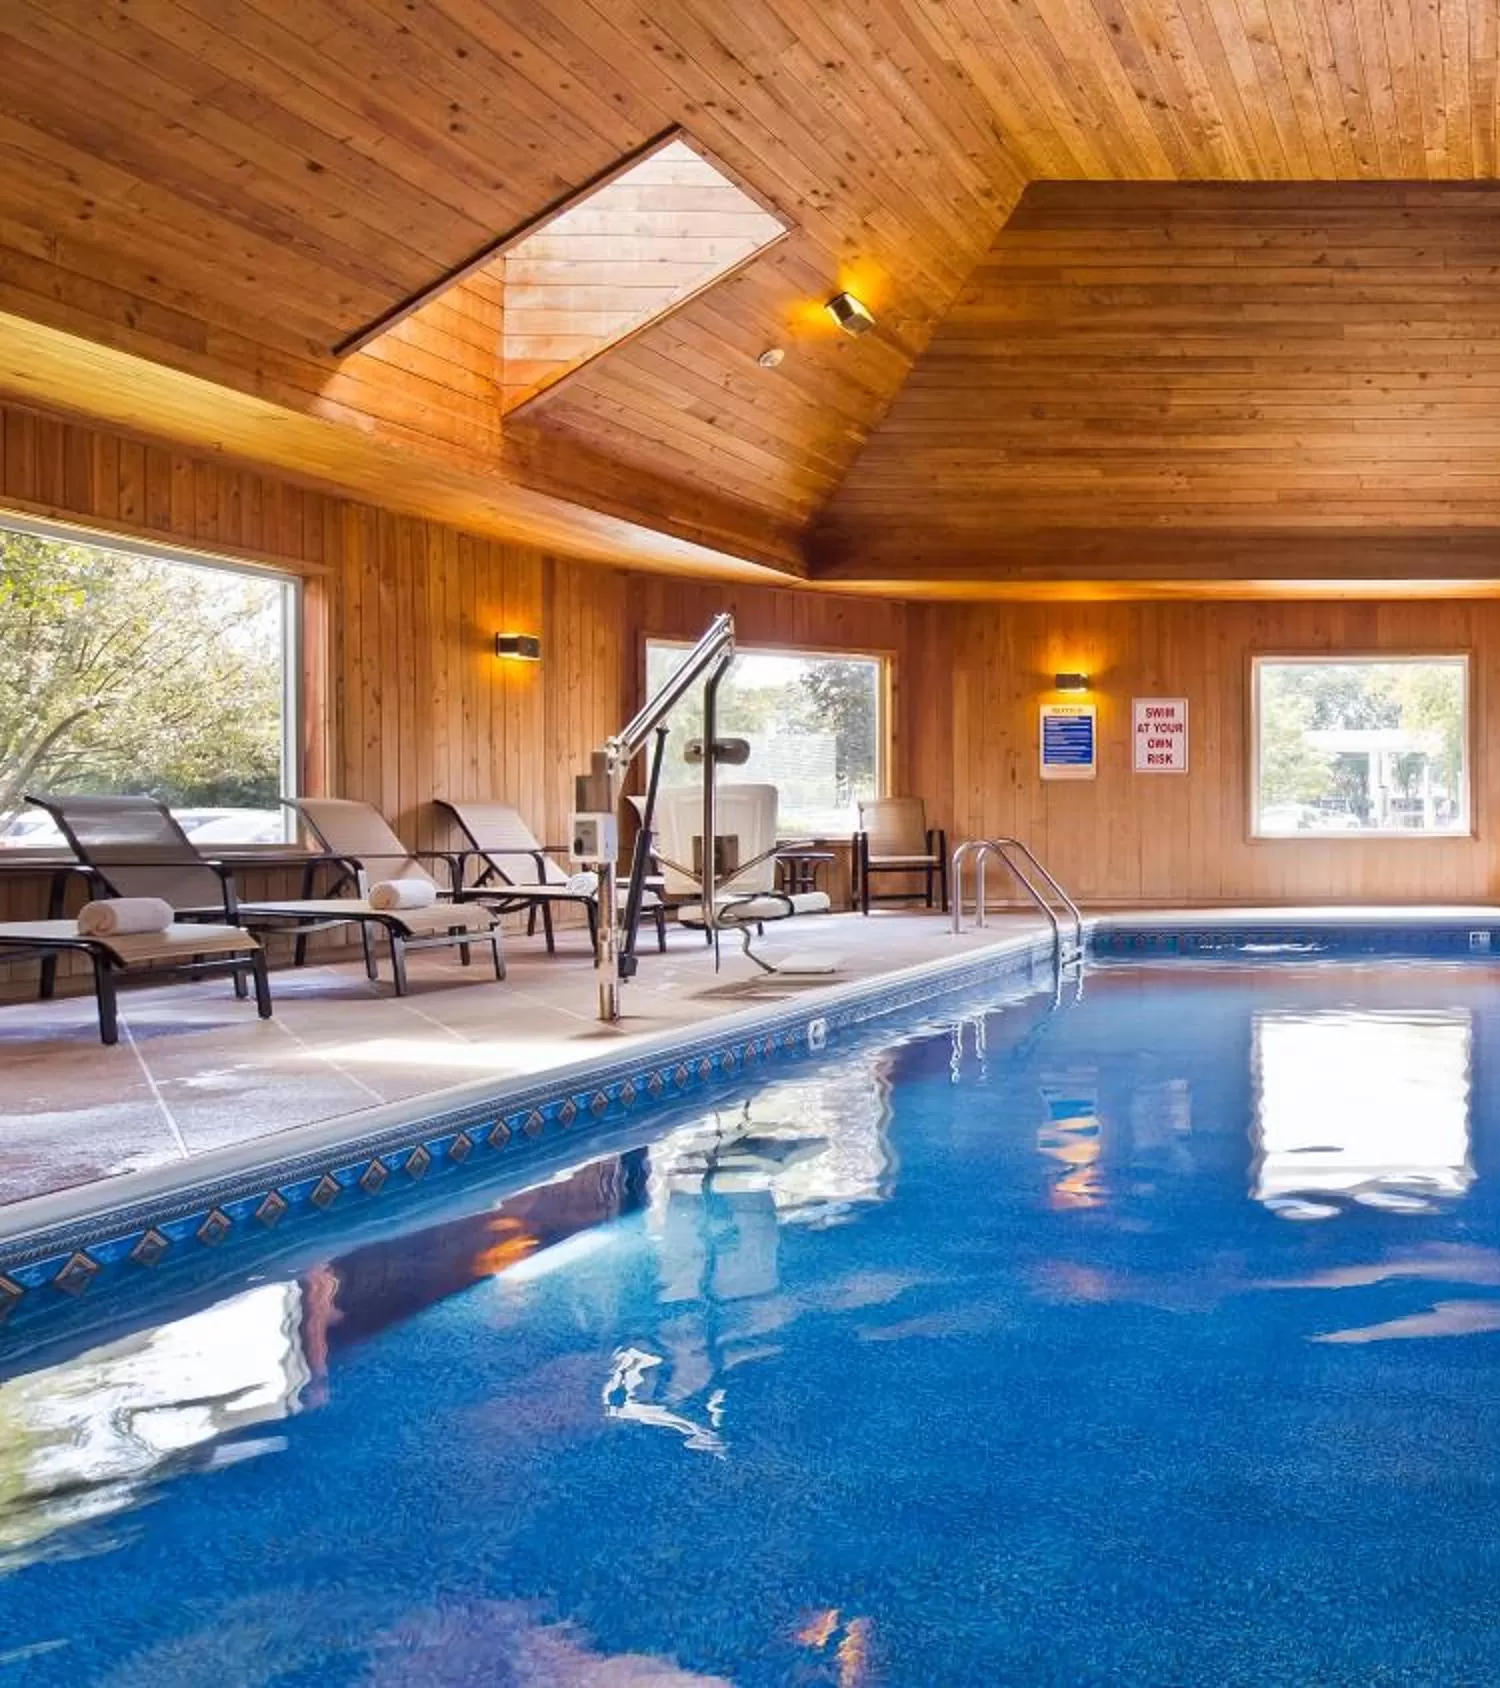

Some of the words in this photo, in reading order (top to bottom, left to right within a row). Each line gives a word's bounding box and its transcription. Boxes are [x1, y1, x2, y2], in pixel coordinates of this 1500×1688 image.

[1146, 708, 1174, 718] SWIM
[1137, 723, 1150, 733] AT
[1154, 723, 1183, 733] YOUR
[1147, 738, 1173, 749] OWN
[1147, 753, 1173, 765] RISK
